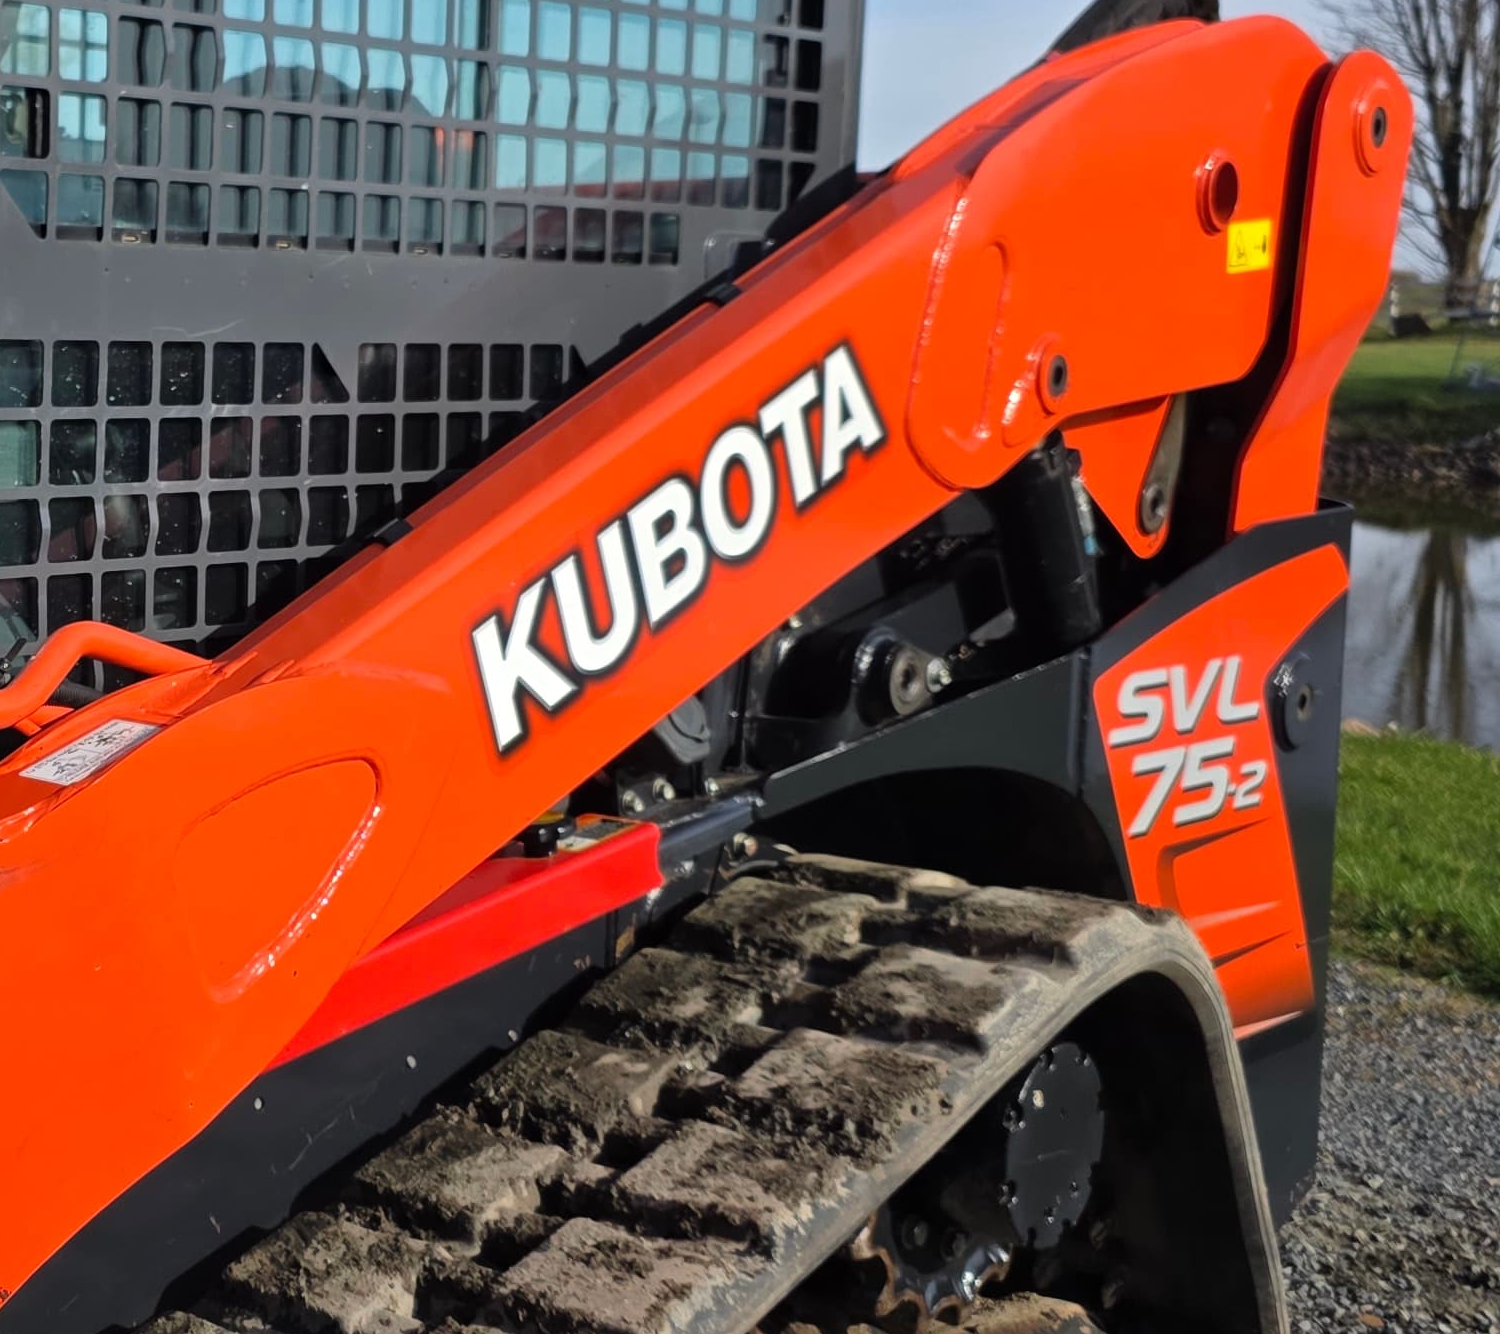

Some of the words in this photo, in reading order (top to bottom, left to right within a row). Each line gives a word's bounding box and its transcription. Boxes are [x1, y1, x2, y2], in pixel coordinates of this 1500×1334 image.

[471, 343, 887, 755] KUBOTA
[1108, 655, 1260, 747] SVL
[1127, 736, 1268, 839] 75-2
